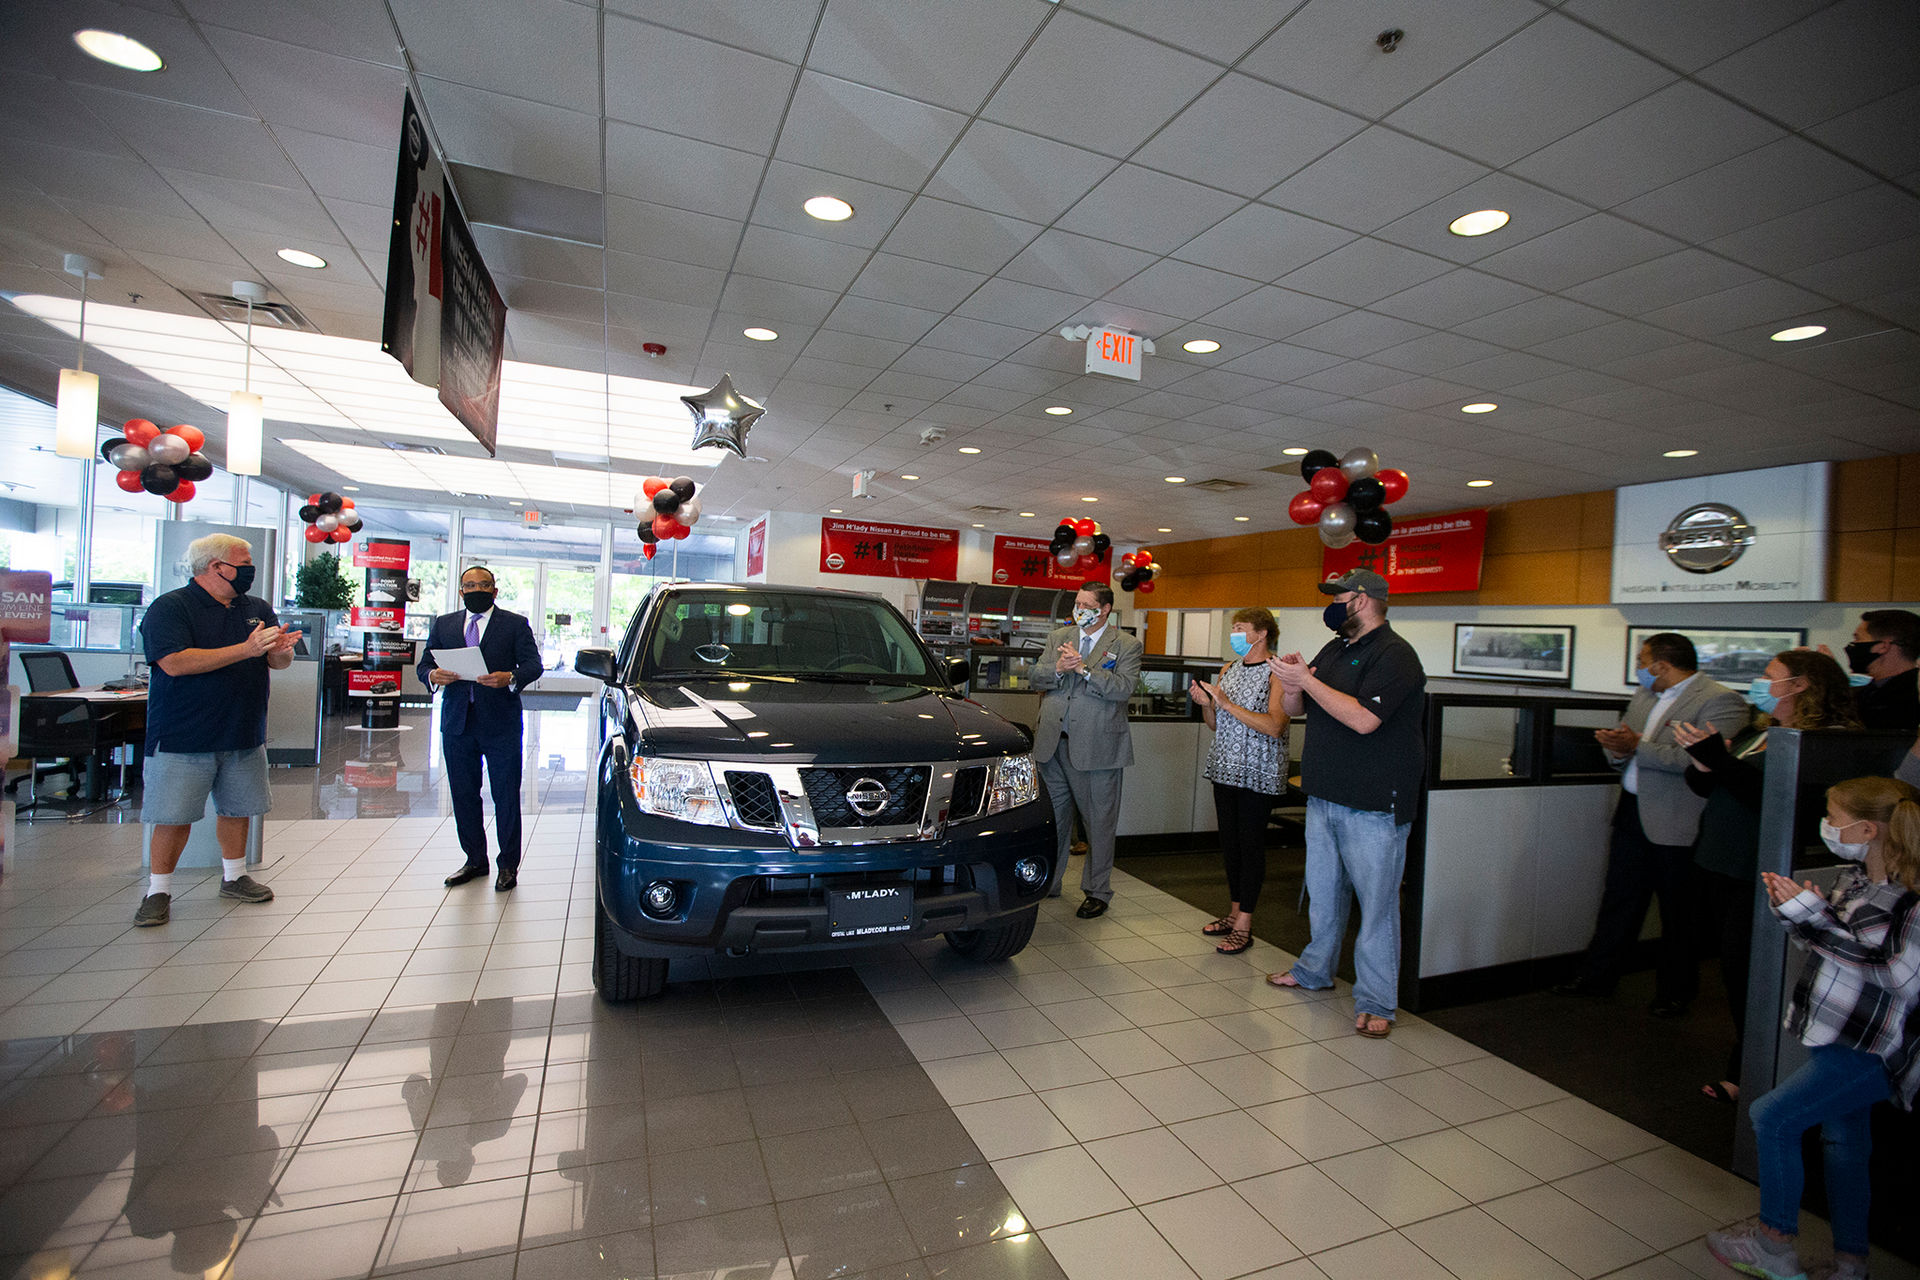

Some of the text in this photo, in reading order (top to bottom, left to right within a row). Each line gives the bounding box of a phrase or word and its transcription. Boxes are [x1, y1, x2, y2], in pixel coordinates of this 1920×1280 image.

[449, 224, 479, 297] NISSAN
[1102, 332, 1135, 364] EXIT
[525, 511, 539, 522] EXIT
[870, 526, 892, 534] Nissan
[901, 529, 920, 537] proud
[1409, 523, 1432, 535] proud
[1432, 522, 1442, 530] to
[1442, 520, 1454, 529] be
[853, 540, 883, 560] #1
[1021, 555, 1048, 577] #1
[1358, 547, 1388, 575] #1
[1400, 557, 1440, 568] Dealer
[1622, 585, 1657, 593] NISSAN
[1, 591, 44, 604] SAN
[19, 604, 43, 612] LINE
[852, 792, 888, 800] NISSAN
[851, 888, 895, 900] M'LADY
